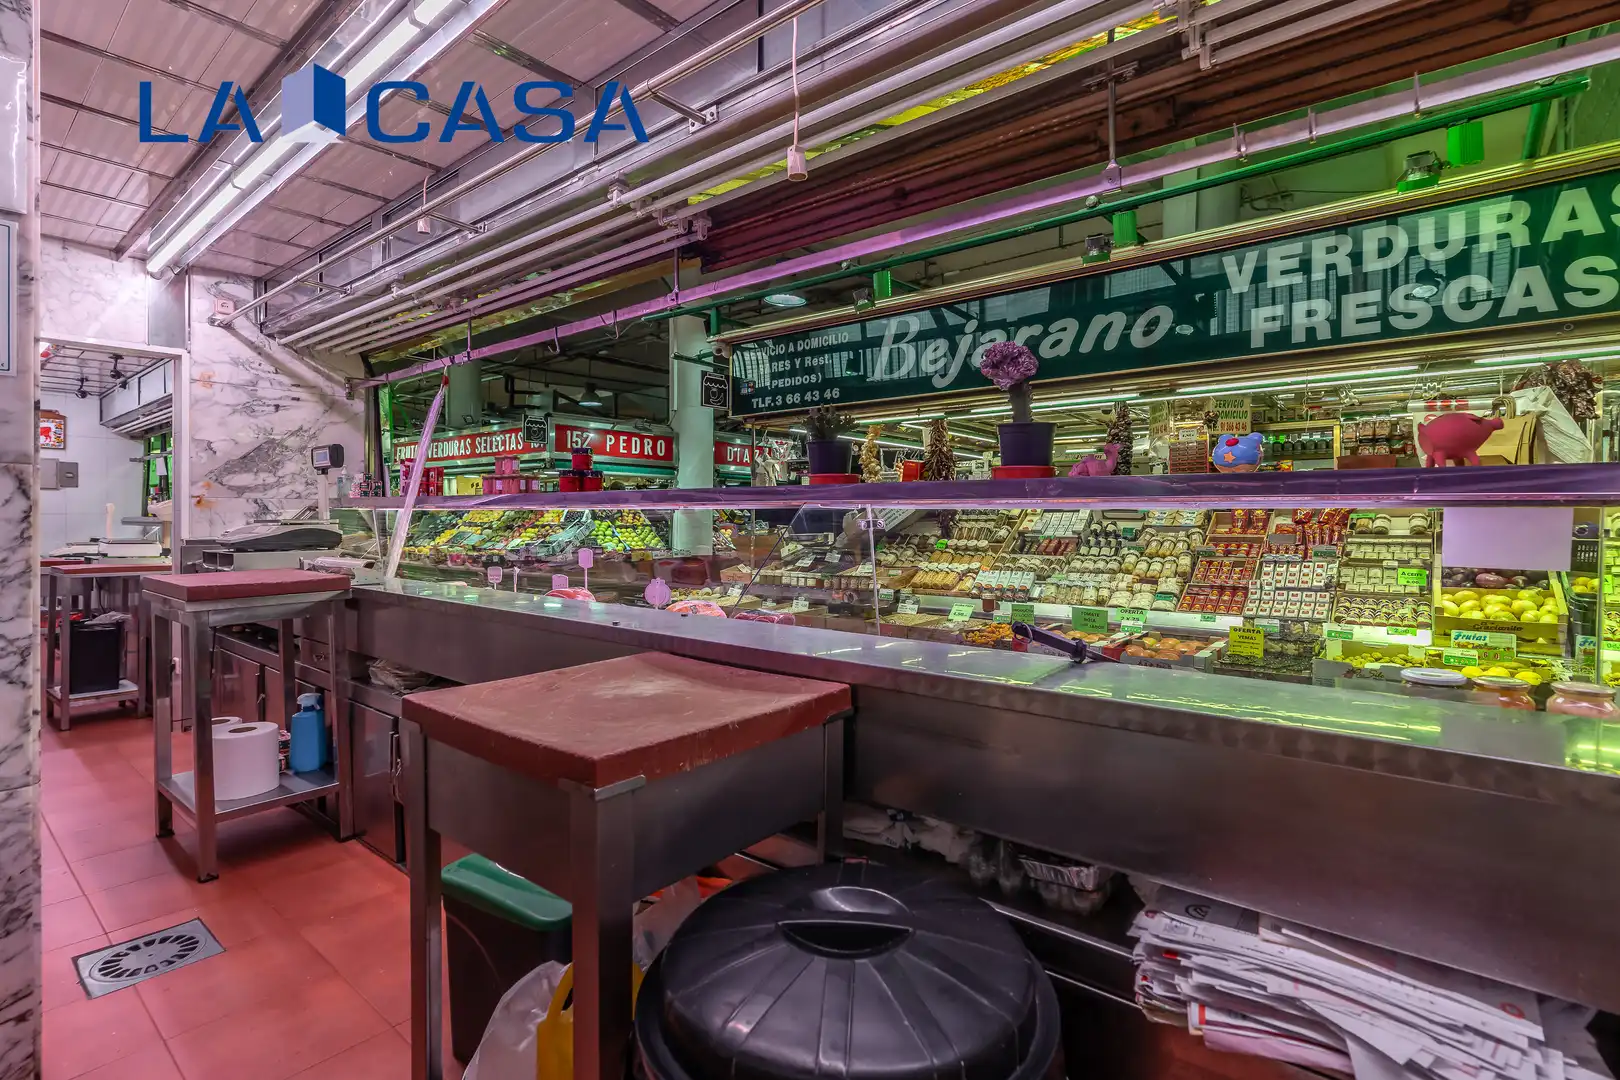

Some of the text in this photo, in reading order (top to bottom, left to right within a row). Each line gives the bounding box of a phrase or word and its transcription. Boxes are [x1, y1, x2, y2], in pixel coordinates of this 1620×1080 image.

[1222, 183, 1620, 294] VERDURA
[1250, 255, 1620, 349] FRESCAS
[744, 332, 849, 358] ERVICIO A DOMICILIO
[865, 305, 1174, 388] Bejarano
[795, 358, 802, 369] Y
[804, 354, 832, 368] Rest.
[786, 393, 801, 404] 66
[804, 390, 820, 401] 43
[823, 388, 840, 399] 46
[1214, 399, 1245, 409] SERVICIO
[396, 431, 523, 461] FRUT VERDURAS SELECTAS
[566, 430, 666, 457] 152 PEDRO
[1453, 631, 1488, 642] Frutas
